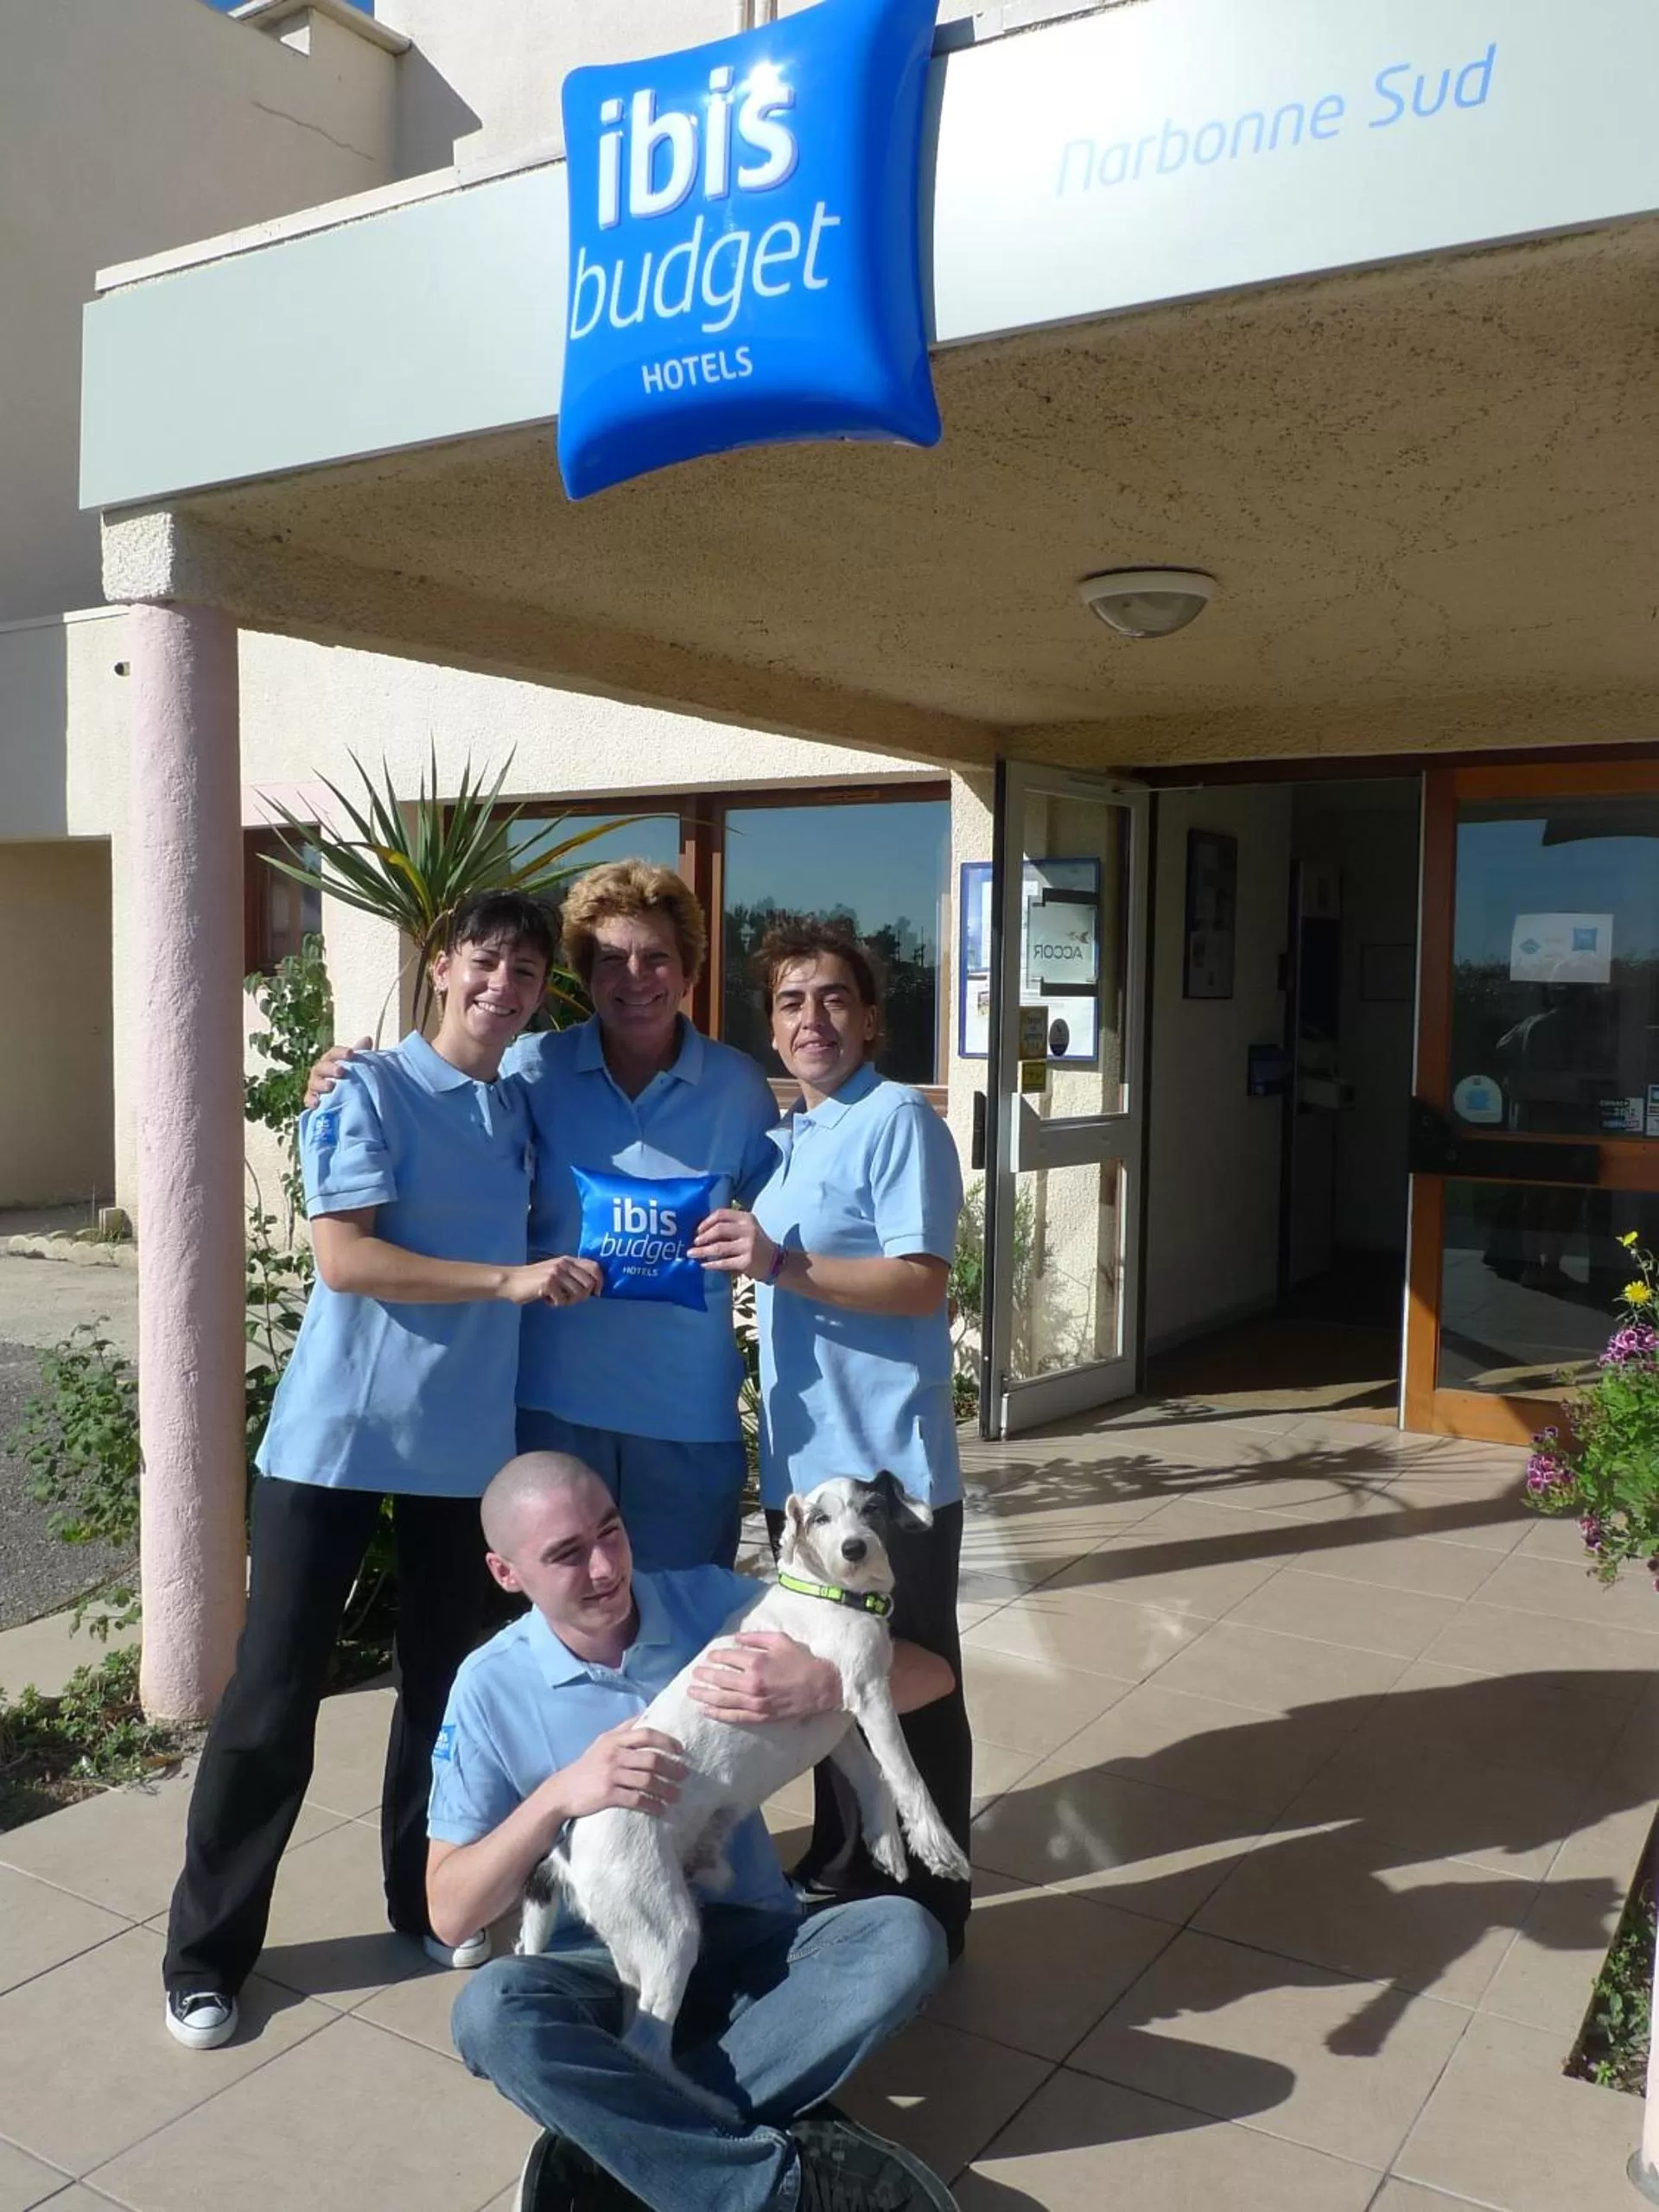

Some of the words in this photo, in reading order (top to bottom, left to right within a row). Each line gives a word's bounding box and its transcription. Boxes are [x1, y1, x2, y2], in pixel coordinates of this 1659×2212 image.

[1368, 41, 1497, 129] Sud
[598, 64, 798, 231] ibis
[570, 200, 841, 340] budget
[641, 346, 753, 395] HOTELS
[613, 1197, 677, 1236] ibis
[600, 1232, 685, 1264] budget
[623, 1266, 658, 1276] HOTELS
